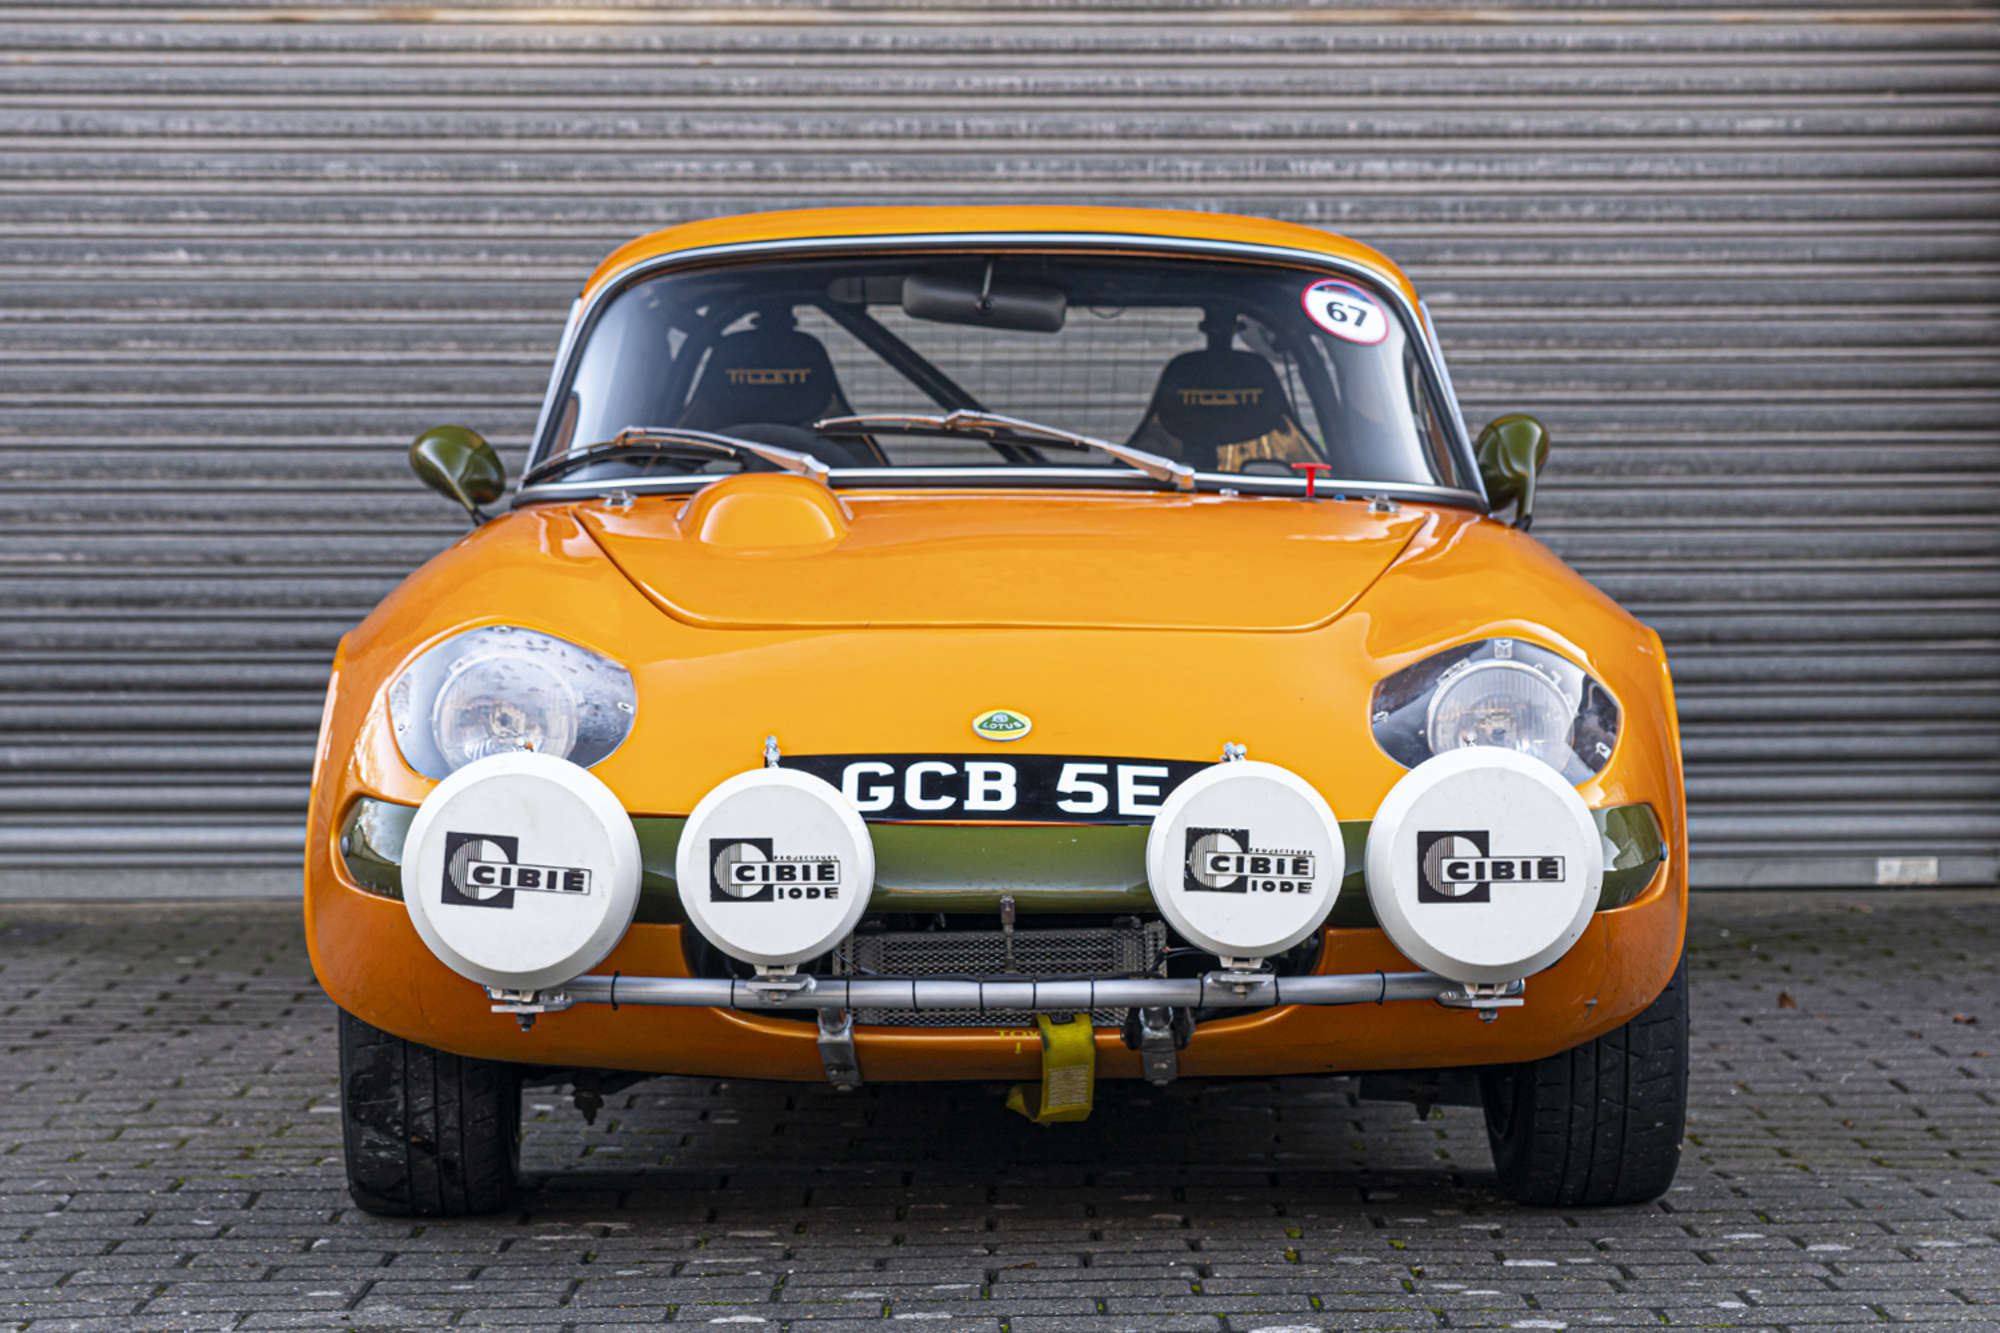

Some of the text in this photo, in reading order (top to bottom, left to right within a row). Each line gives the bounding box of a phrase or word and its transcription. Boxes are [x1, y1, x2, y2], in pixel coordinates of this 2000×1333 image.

[1326, 301, 1367, 327] 67
[982, 722, 1022, 730] LOTUS
[842, 761, 1168, 817] GCB 5E
[778, 887, 839, 900] IODE
[1251, 880, 1313, 894] IODE
